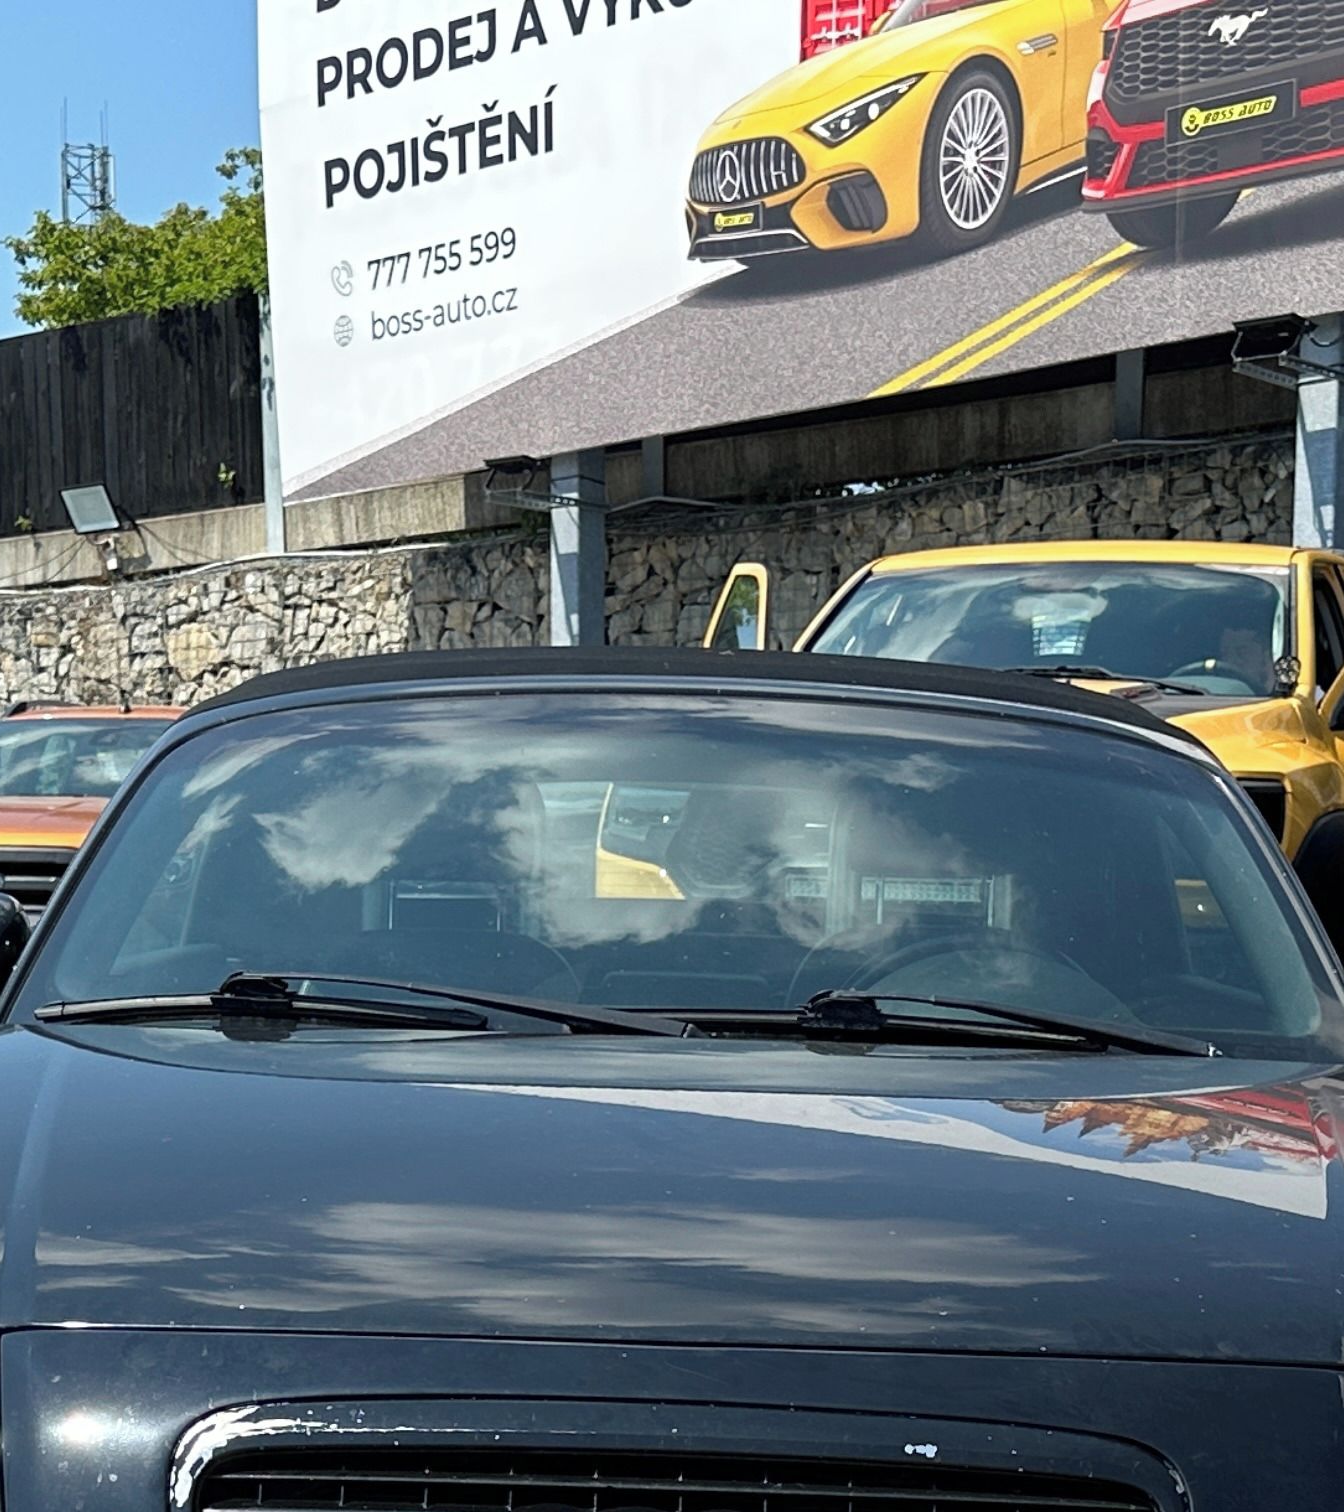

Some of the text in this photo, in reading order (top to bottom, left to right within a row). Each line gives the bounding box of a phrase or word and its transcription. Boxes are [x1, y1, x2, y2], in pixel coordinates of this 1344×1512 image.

[317, 8, 496, 108] PRODEJ
[511, 0, 548, 54] A
[324, 84, 558, 208] POJIŠTĚNÍ
[367, 227, 516, 290] 777 755 599
[371, 287, 518, 341] boss-auto.cz
